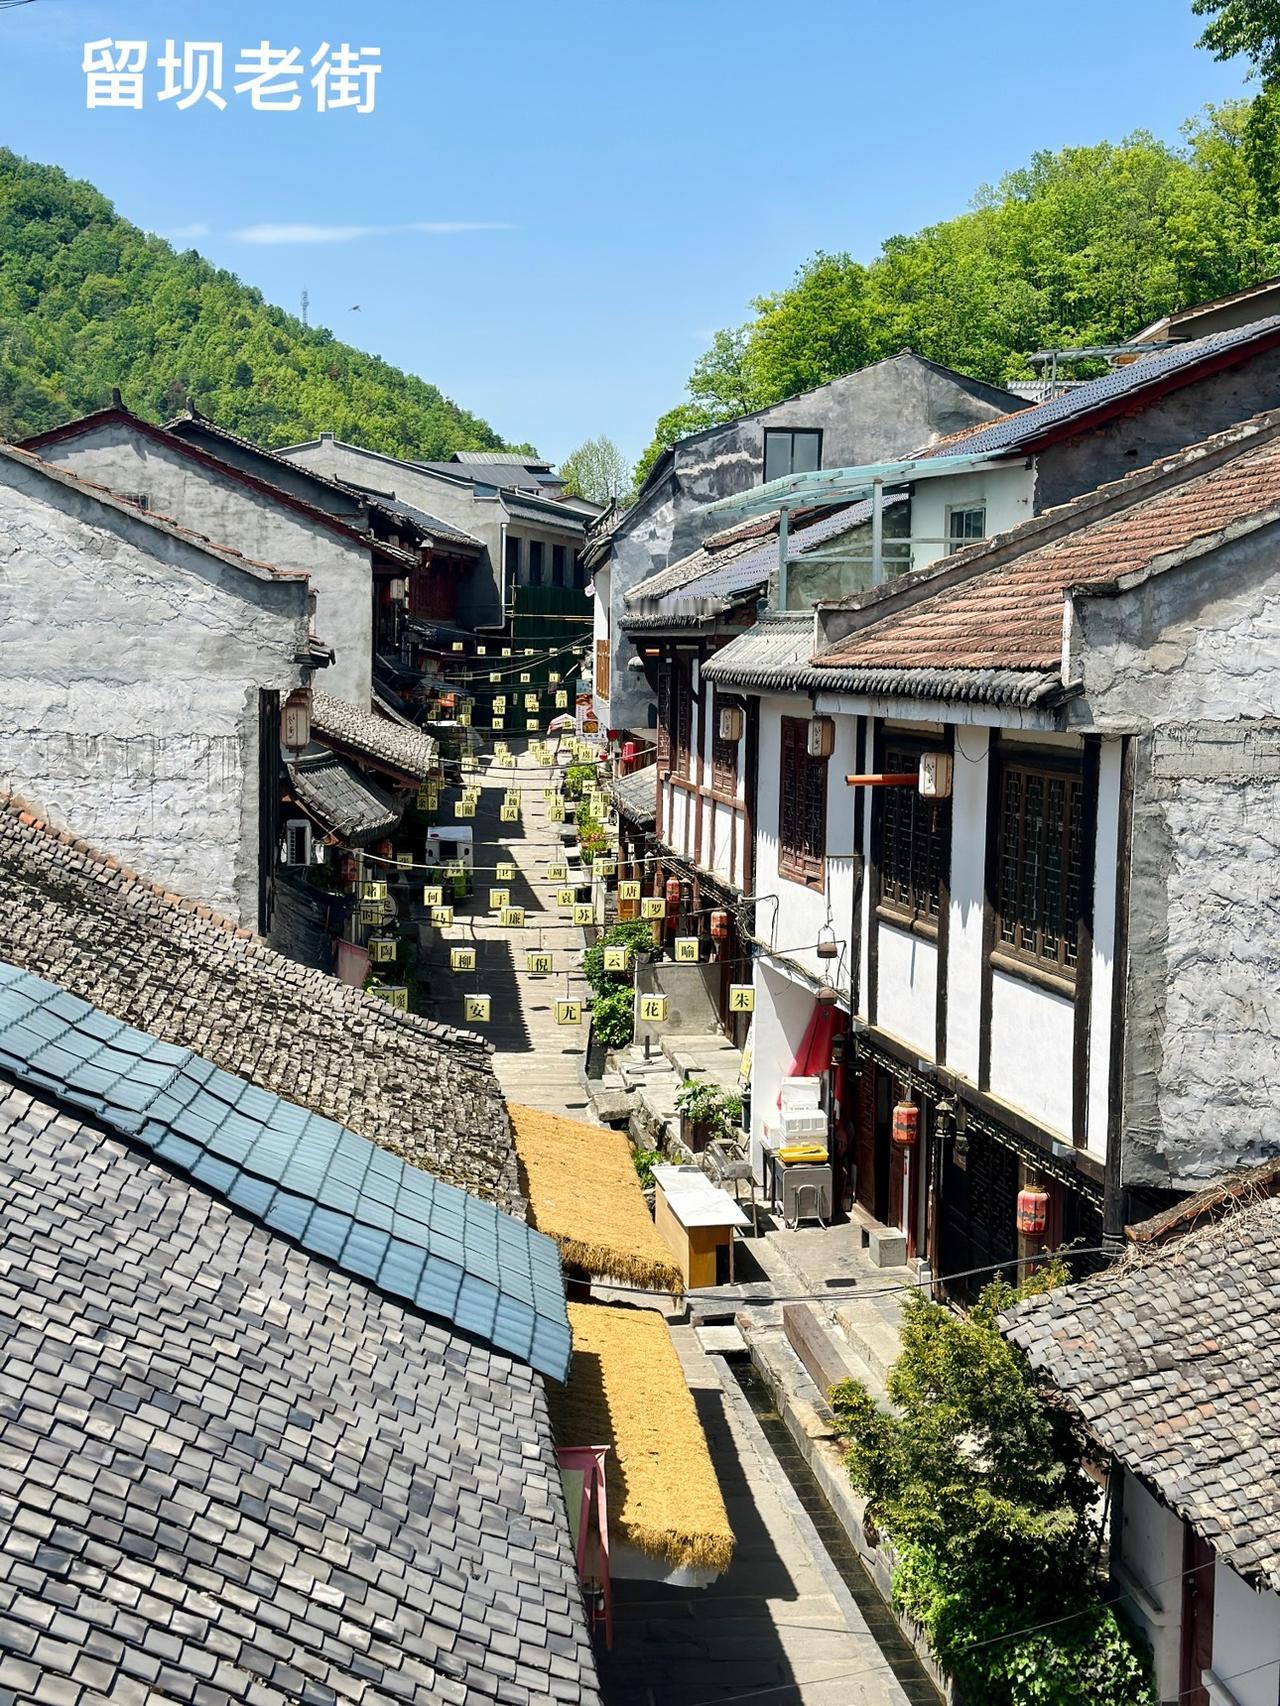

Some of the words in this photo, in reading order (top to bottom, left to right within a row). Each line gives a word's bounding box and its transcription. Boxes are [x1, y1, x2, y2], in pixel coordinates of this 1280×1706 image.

[427, 892, 438, 903] 何
[625, 885, 637, 897] 唐
[577, 909, 590, 921] 苏
[651, 903, 662, 916] 罗
[458, 955, 472, 969] 柳
[535, 958, 548, 972] 倪
[608, 953, 621, 968] 云
[735, 993, 749, 1008] 朱
[469, 1003, 486, 1019] 安
[562, 1005, 577, 1021] 尤
[644, 1002, 659, 1017] 花
